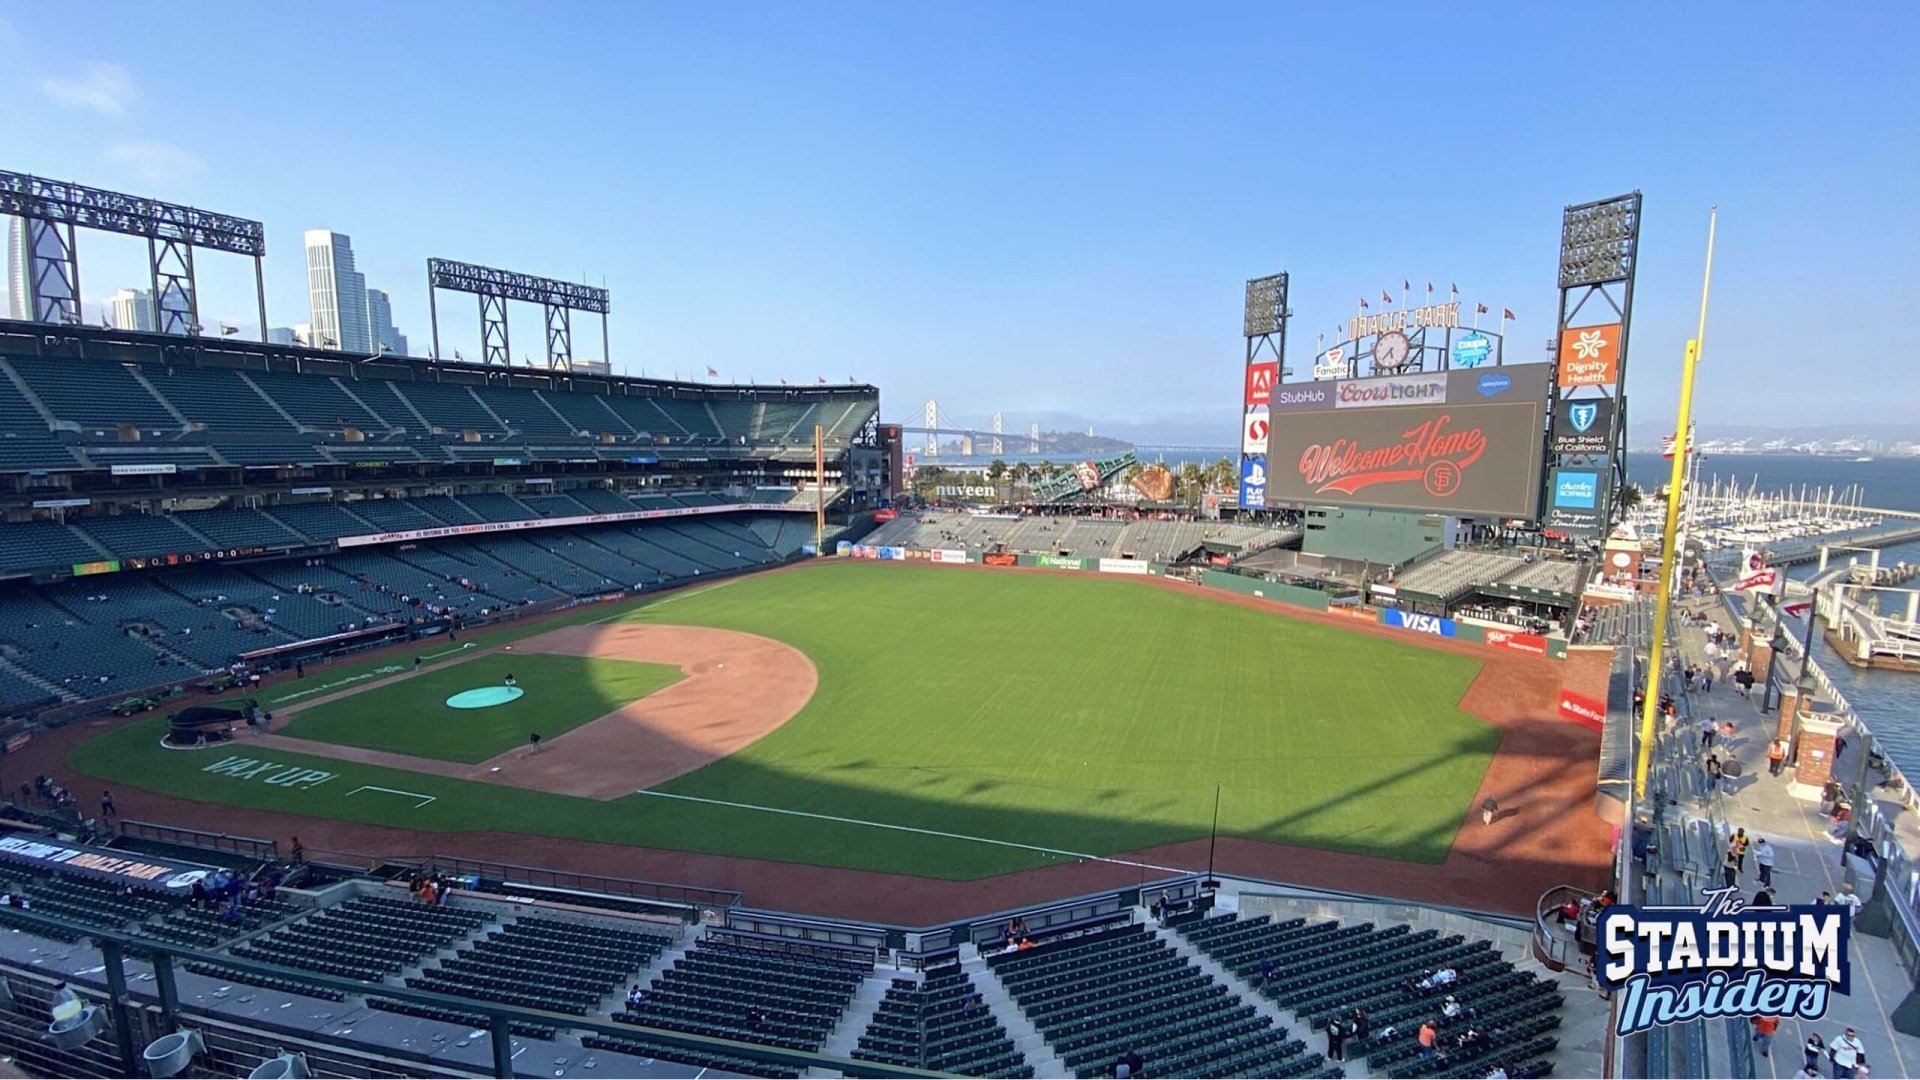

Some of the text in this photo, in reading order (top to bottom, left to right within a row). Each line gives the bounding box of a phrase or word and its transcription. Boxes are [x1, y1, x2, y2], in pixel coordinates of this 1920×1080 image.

[1348, 302, 1460, 340] ORACLE PARK
[1567, 362, 1608, 375] Dignity
[1568, 372, 1605, 383] Health
[1281, 390, 1325, 404] StubHub
[1341, 383, 1435, 403] Coors LIGHT
[1558, 435, 1604, 444] Blue Shield
[1299, 415, 1485, 485] Welcome Home
[1555, 443, 1606, 452] of California
[936, 485, 995, 496] nuveen
[1050, 557, 1081, 567] National
[1399, 611, 1442, 635] VISA
[1508, 641, 1544, 654] Insurance
[202, 756, 339, 789] VAX UP!
[46, 849, 82, 862] TO
[116, 863, 173, 880] PARK
